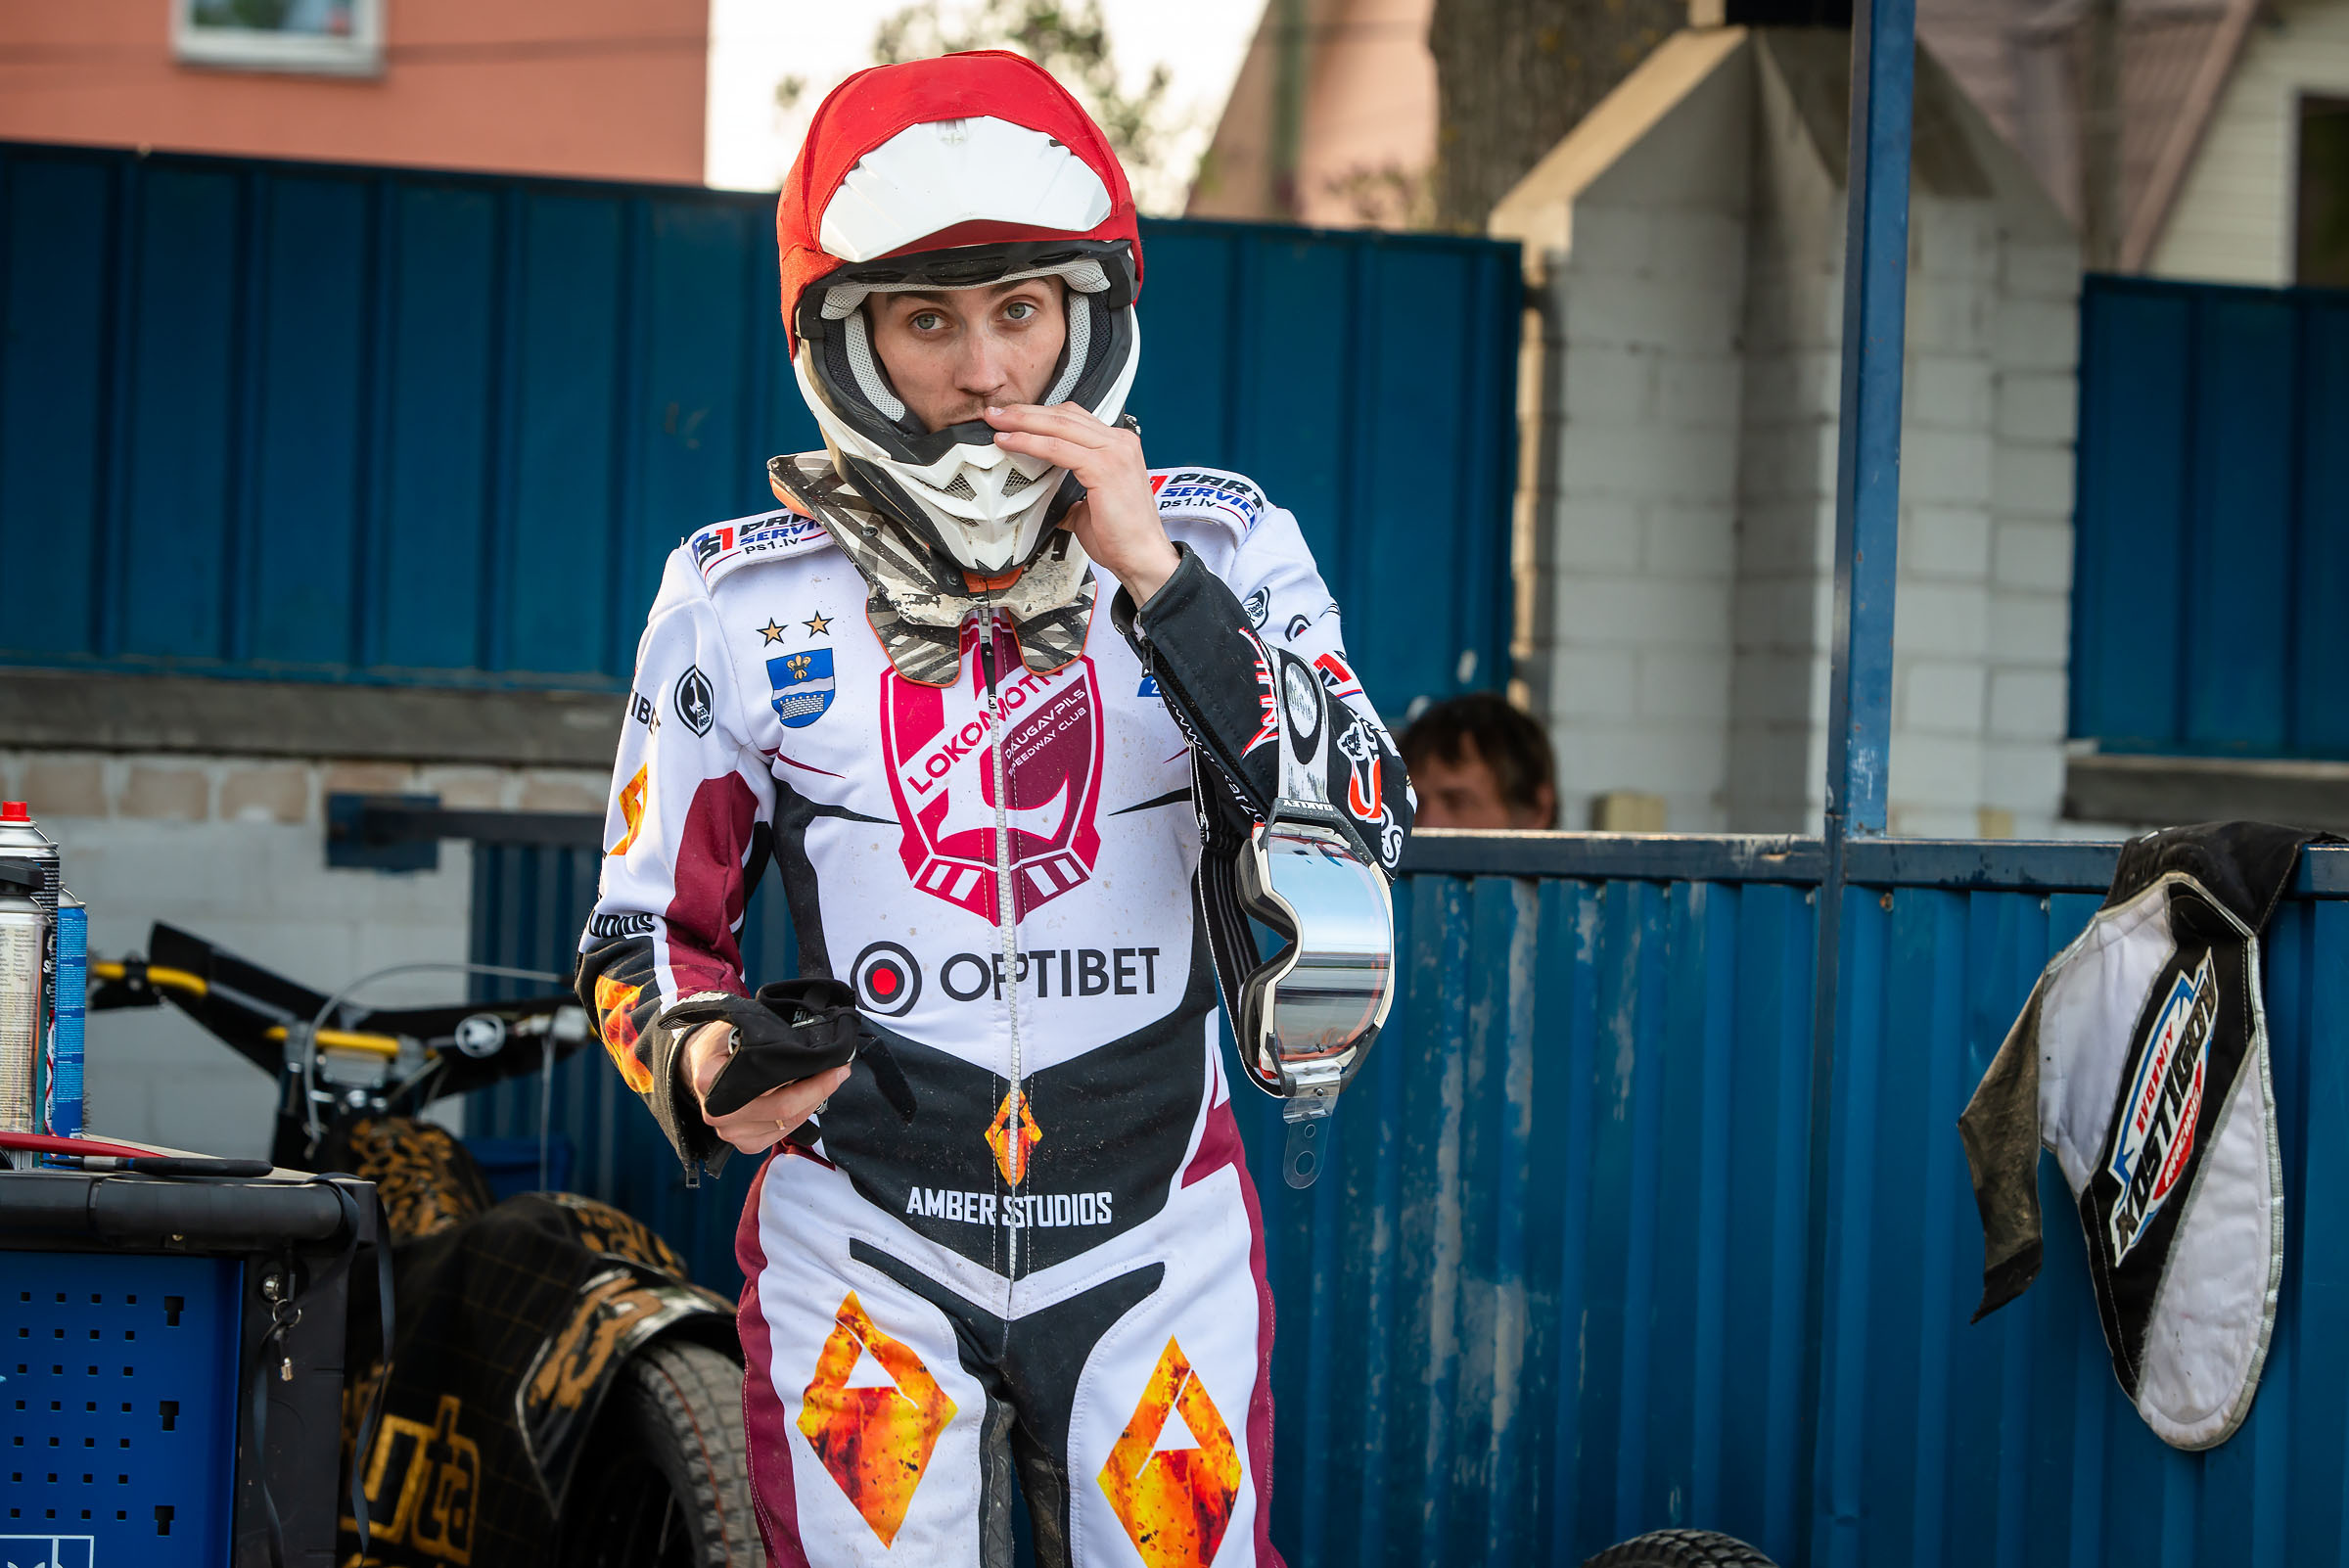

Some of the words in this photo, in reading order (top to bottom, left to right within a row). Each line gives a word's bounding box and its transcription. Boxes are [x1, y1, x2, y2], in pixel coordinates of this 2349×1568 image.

[739, 513, 813, 537] PAR
[1159, 497, 1217, 511] ps1.lv
[739, 519, 822, 547] SERVI
[744, 536, 800, 555] ps1.lv
[906, 670, 1064, 796] LOKOMOTI
[1004, 688, 1086, 760] DAUGAVPILS
[1008, 729, 1056, 776] SPEEDWAY
[1058, 707, 1087, 731] CLUB
[1283, 799, 1334, 811] OAKLEY
[940, 946, 1160, 1002] OPTIBET
[2116, 959, 2217, 1255] KOSTIGOV
[2164, 1093, 2202, 1188] RACING
[905, 1186, 996, 1226] AMBER
[1001, 1191, 1113, 1228] STUDIOS
